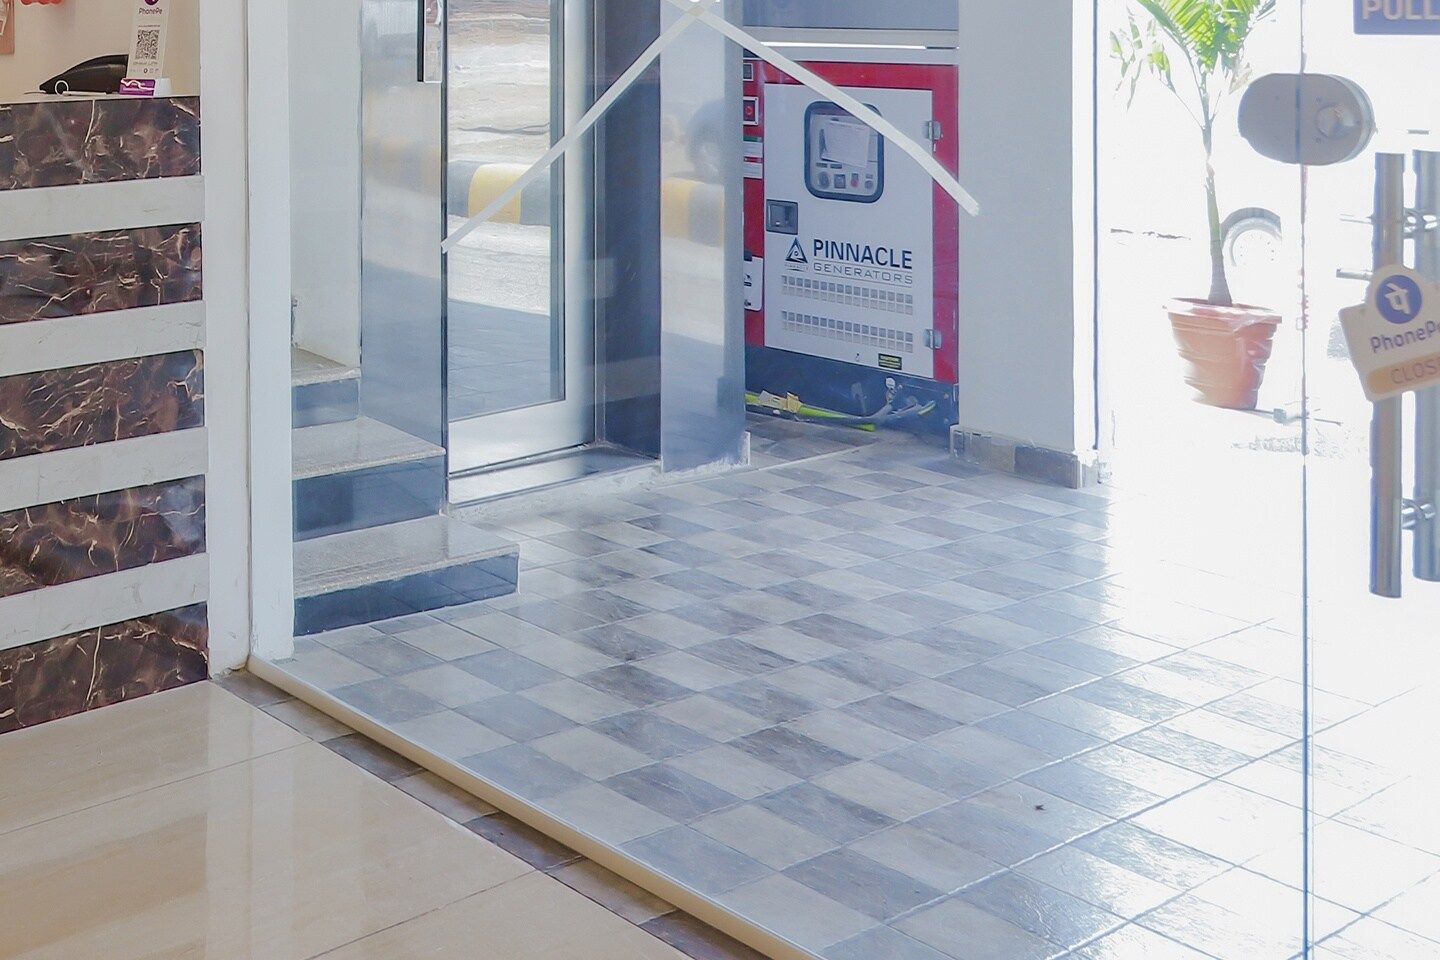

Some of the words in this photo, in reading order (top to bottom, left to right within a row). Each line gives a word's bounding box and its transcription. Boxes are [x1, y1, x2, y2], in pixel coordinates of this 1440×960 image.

[138, 7, 163, 15] PhonePe
[813, 238, 913, 270] PINNACLE
[813, 262, 913, 285] GENERATORS
[1391, 354, 1440, 384] CLOS
